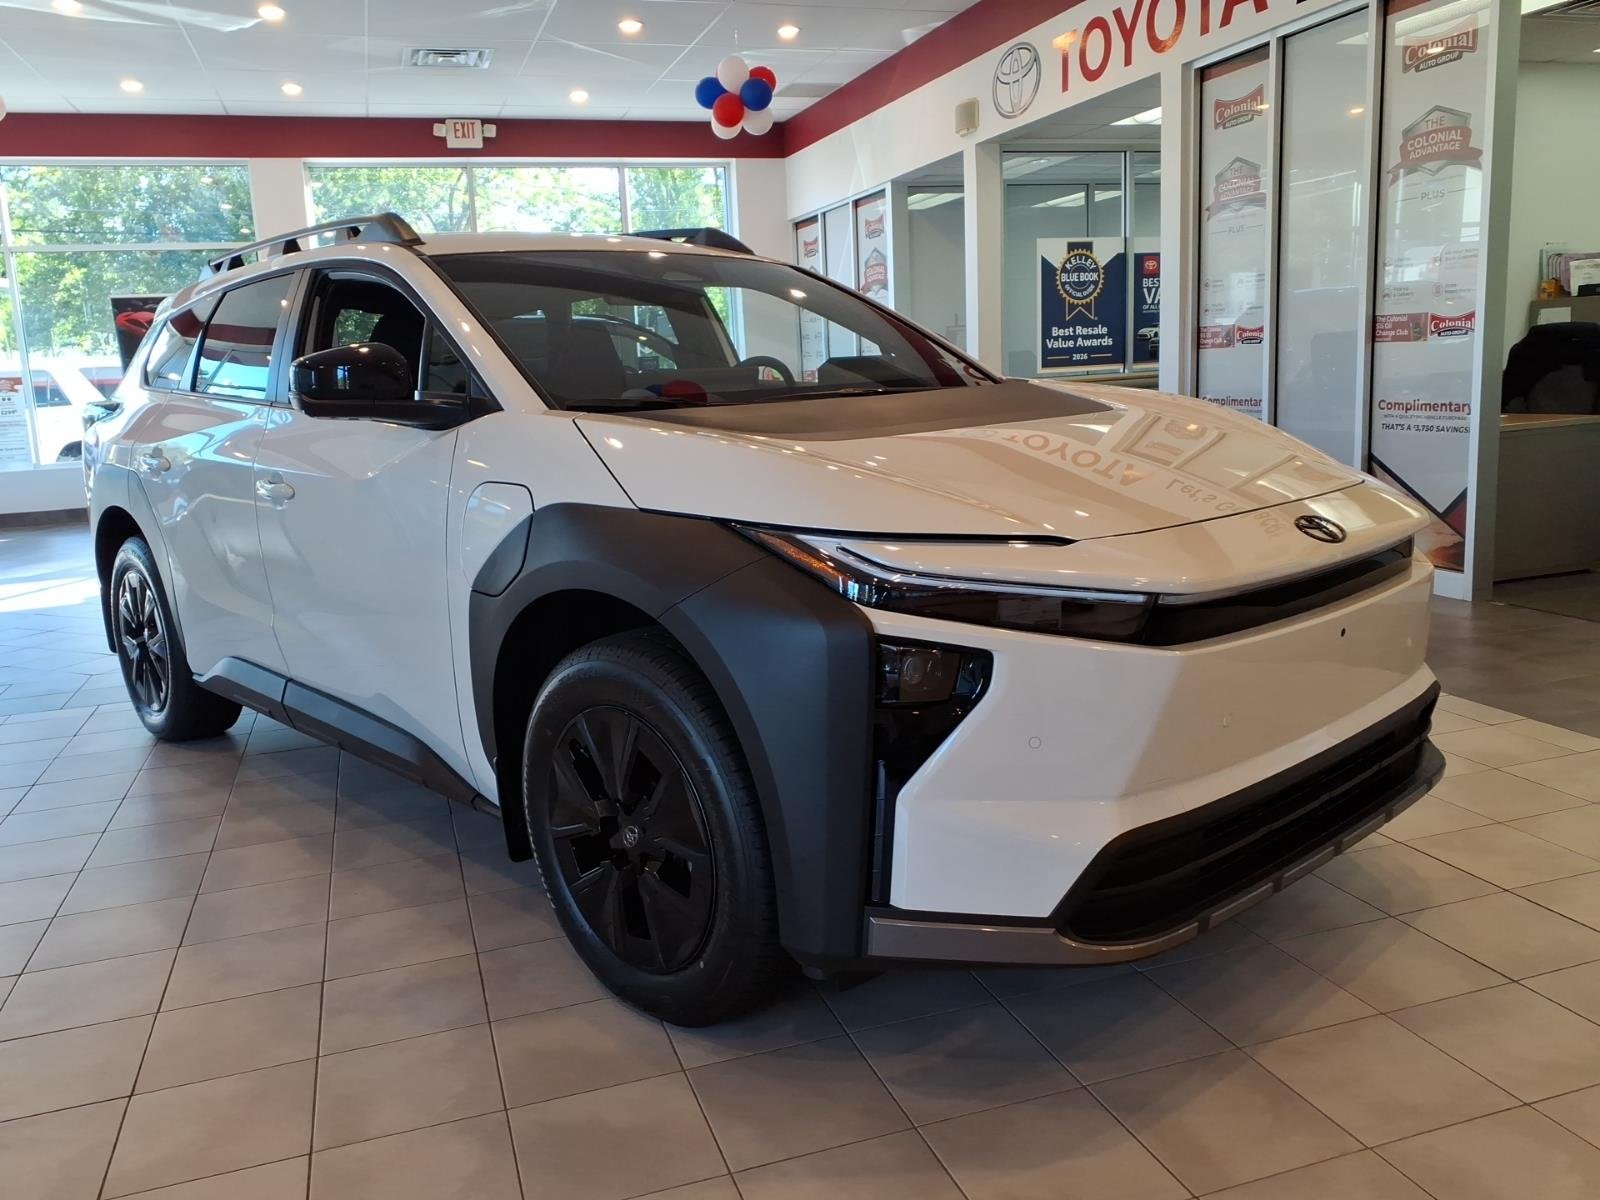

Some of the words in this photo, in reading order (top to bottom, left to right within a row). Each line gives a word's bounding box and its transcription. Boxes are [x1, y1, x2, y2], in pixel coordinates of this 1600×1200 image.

[1405, 29, 1474, 65] Colonial
[1419, 60, 1437, 71] AUTO
[1437, 52, 1460, 65] GROUP
[1216, 95, 1262, 123] Colonial
[1424, 116, 1446, 129] THE
[453, 121, 476, 139] EXIT
[1407, 129, 1463, 151] COLONIAL
[1409, 142, 1461, 160] ADVANTAGE
[1420, 189, 1446, 201] PLUS
[1065, 256, 1097, 270] KELLEY
[1061, 272, 1079, 282] BLUE
[1080, 272, 1099, 281] BOOK
[1142, 278, 1160, 287] BES
[1052, 326, 1074, 337] Best
[1075, 323, 1108, 336] Resale
[1431, 317, 1475, 332] Colonial
[1046, 337, 1074, 349] Value
[1076, 335, 1113, 348] Awards
[1072, 353, 1088, 361] 2026
[1378, 399, 1472, 416] Complimentary
[1381, 423, 1405, 431] THAT'S
